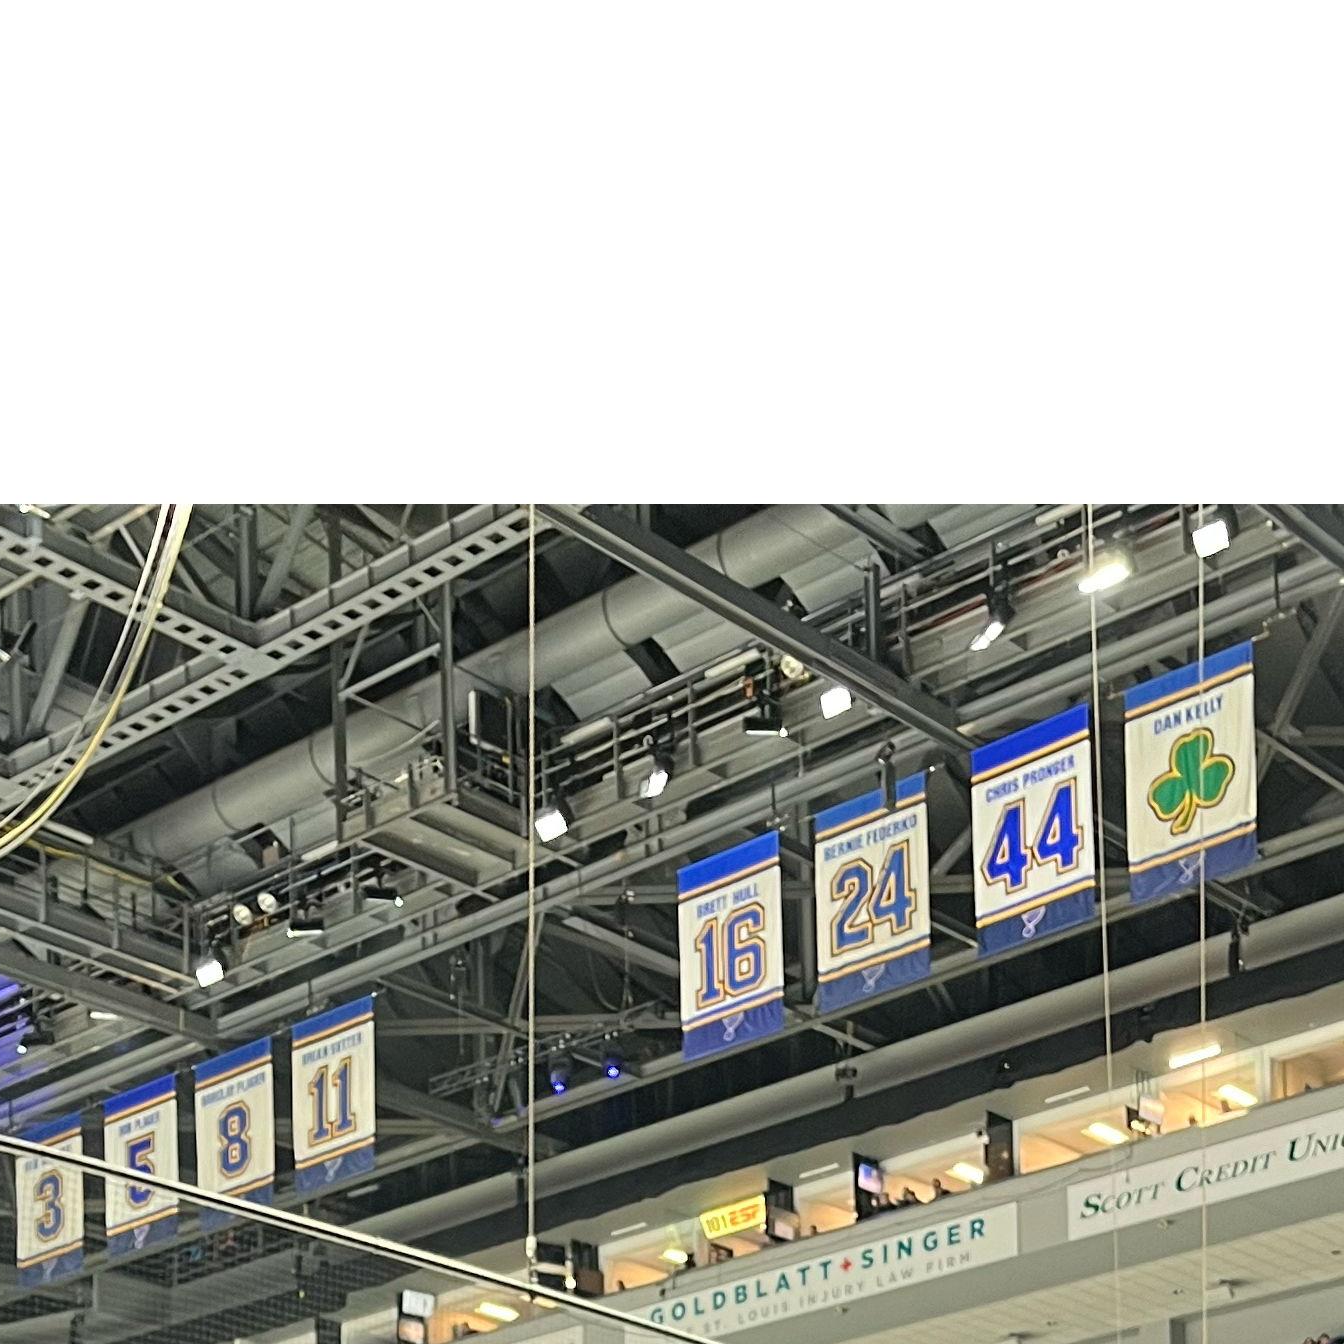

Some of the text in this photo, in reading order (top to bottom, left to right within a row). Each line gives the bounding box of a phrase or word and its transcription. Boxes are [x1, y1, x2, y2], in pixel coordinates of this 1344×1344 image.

[1154, 693, 1224, 735] DAN KELLY
[986, 775, 1019, 803] CHRIS
[824, 836, 863, 861] BERNIE
[981, 776, 1084, 895] 44
[697, 895, 727, 918] BRETT
[830, 838, 917, 958] 24
[695, 901, 766, 1010] 16
[308, 1055, 357, 1148] 11
[125, 1131, 156, 1210] 5
[218, 1100, 251, 1180] 8
[33, 1169, 64, 1243] 3
[1079, 1181, 1166, 1220] SCOTT
[1175, 1150, 1278, 1194] CREDIT
[649, 1217, 987, 1326] GOLDBLATT SINGER
[876, 1267, 914, 1289] LAW
